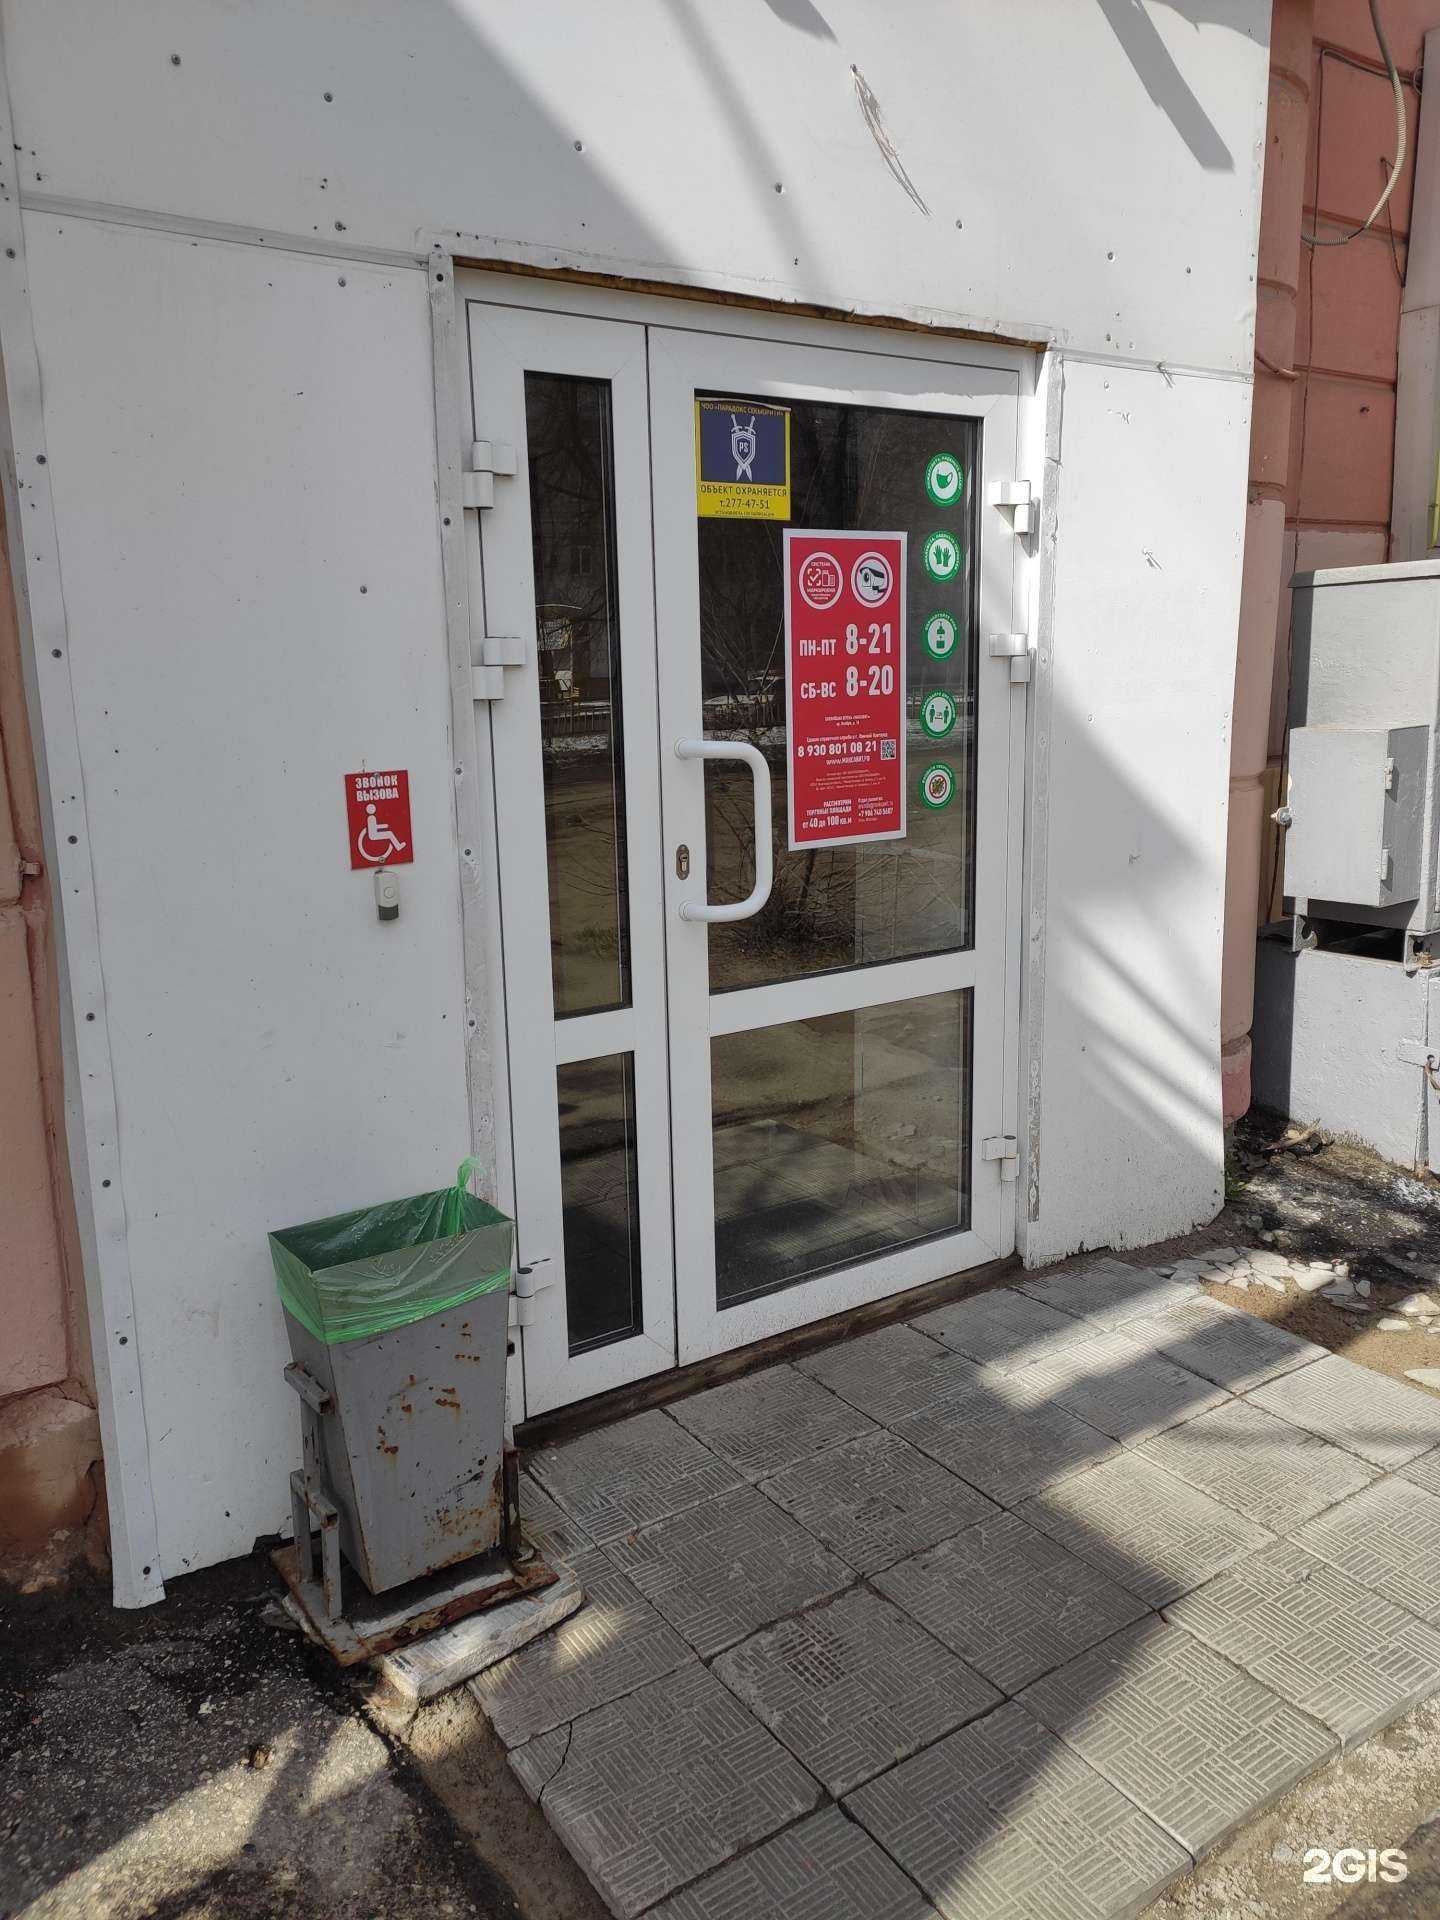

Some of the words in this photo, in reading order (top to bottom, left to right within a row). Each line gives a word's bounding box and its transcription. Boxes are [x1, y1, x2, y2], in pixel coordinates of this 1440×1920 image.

[739, 441, 749, 453] PS
[700, 484, 733, 495] ОБЪЕКТ
[735, 486, 787, 497] ОХРАНЯЕТСЯ
[799, 639, 837, 656] ПН-ПТ
[845, 623, 892, 655] 8-21
[800, 681, 837, 699] СБ-ВС
[845, 664, 894, 697] 8-20
[797, 745, 805, 758] 8
[806, 744, 827, 757] 930
[828, 742, 847, 755] 801
[865, 740, 877, 753] 21
[355, 775, 398, 789] ЗВОНОК
[356, 787, 400, 801] ВЫЗОВА
[809, 817, 818, 828] 40
[827, 816, 840, 827] 100
